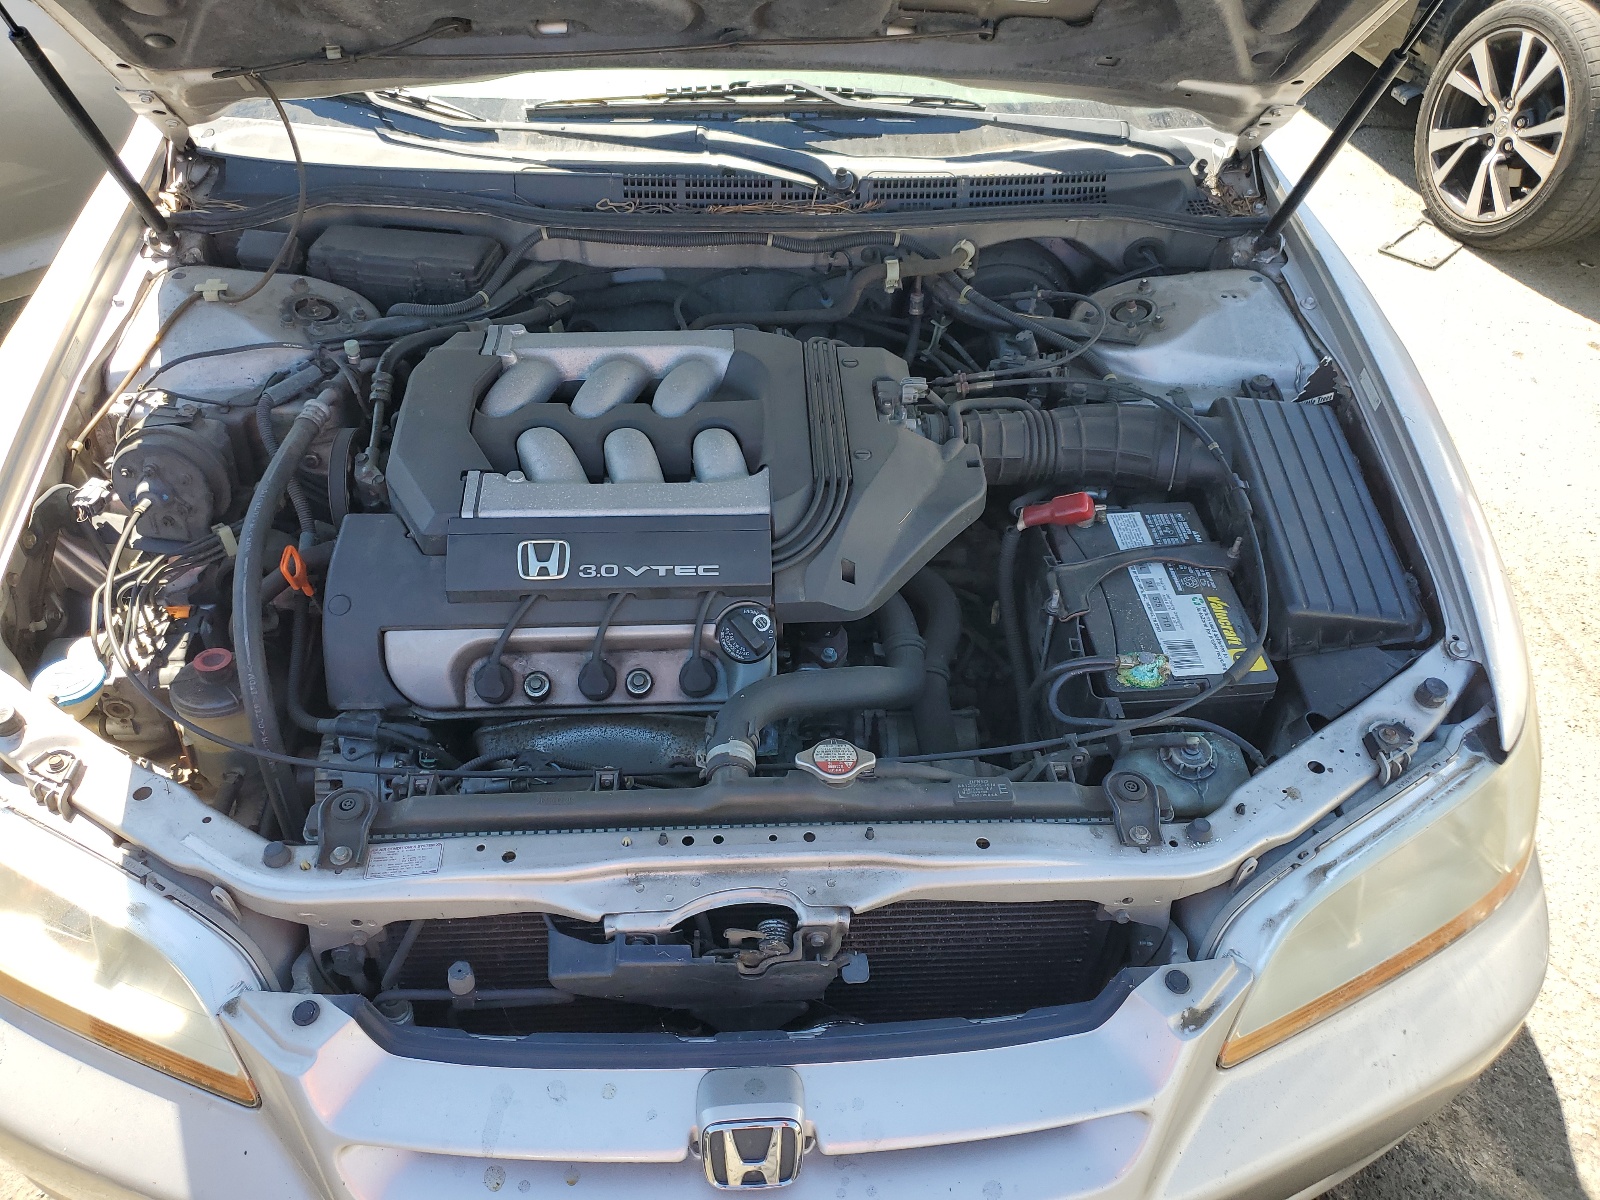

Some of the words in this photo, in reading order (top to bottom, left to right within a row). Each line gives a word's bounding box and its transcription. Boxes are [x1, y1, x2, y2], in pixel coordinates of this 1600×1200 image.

[578, 564, 619, 578] 3.0
[623, 564, 720, 577] VTEC
[1151, 595, 1162, 608] 575
[1206, 596, 1243, 645] Valucraft
